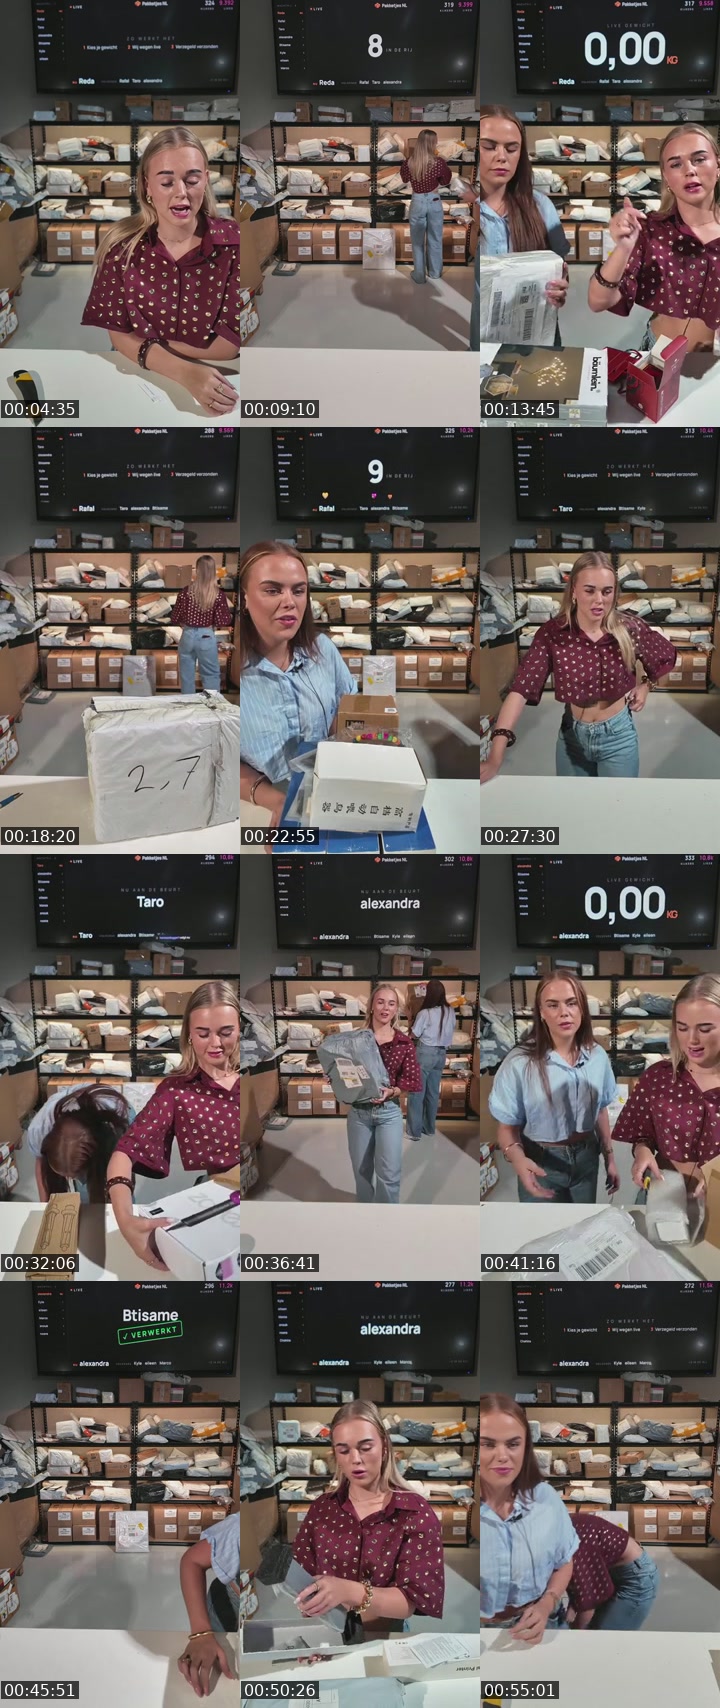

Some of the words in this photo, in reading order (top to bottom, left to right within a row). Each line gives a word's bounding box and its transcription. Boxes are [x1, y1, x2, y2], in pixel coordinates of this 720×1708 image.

[368, 34, 383, 58] 8
[584, 31, 666, 71] 0,00
[666, 56, 678, 64] KG
[368, 459, 384, 484] 9
[127, 755, 200, 793] 2,7
[136, 896, 164, 907] Taro
[360, 897, 420, 909] alexandra
[584, 885, 666, 925] 0,00
[666, 910, 678, 919] KG
[123, 1308, 178, 1321] Btisame
[131, 1326, 177, 1338] VERWERKT
[360, 1323, 420, 1335] alexandra
